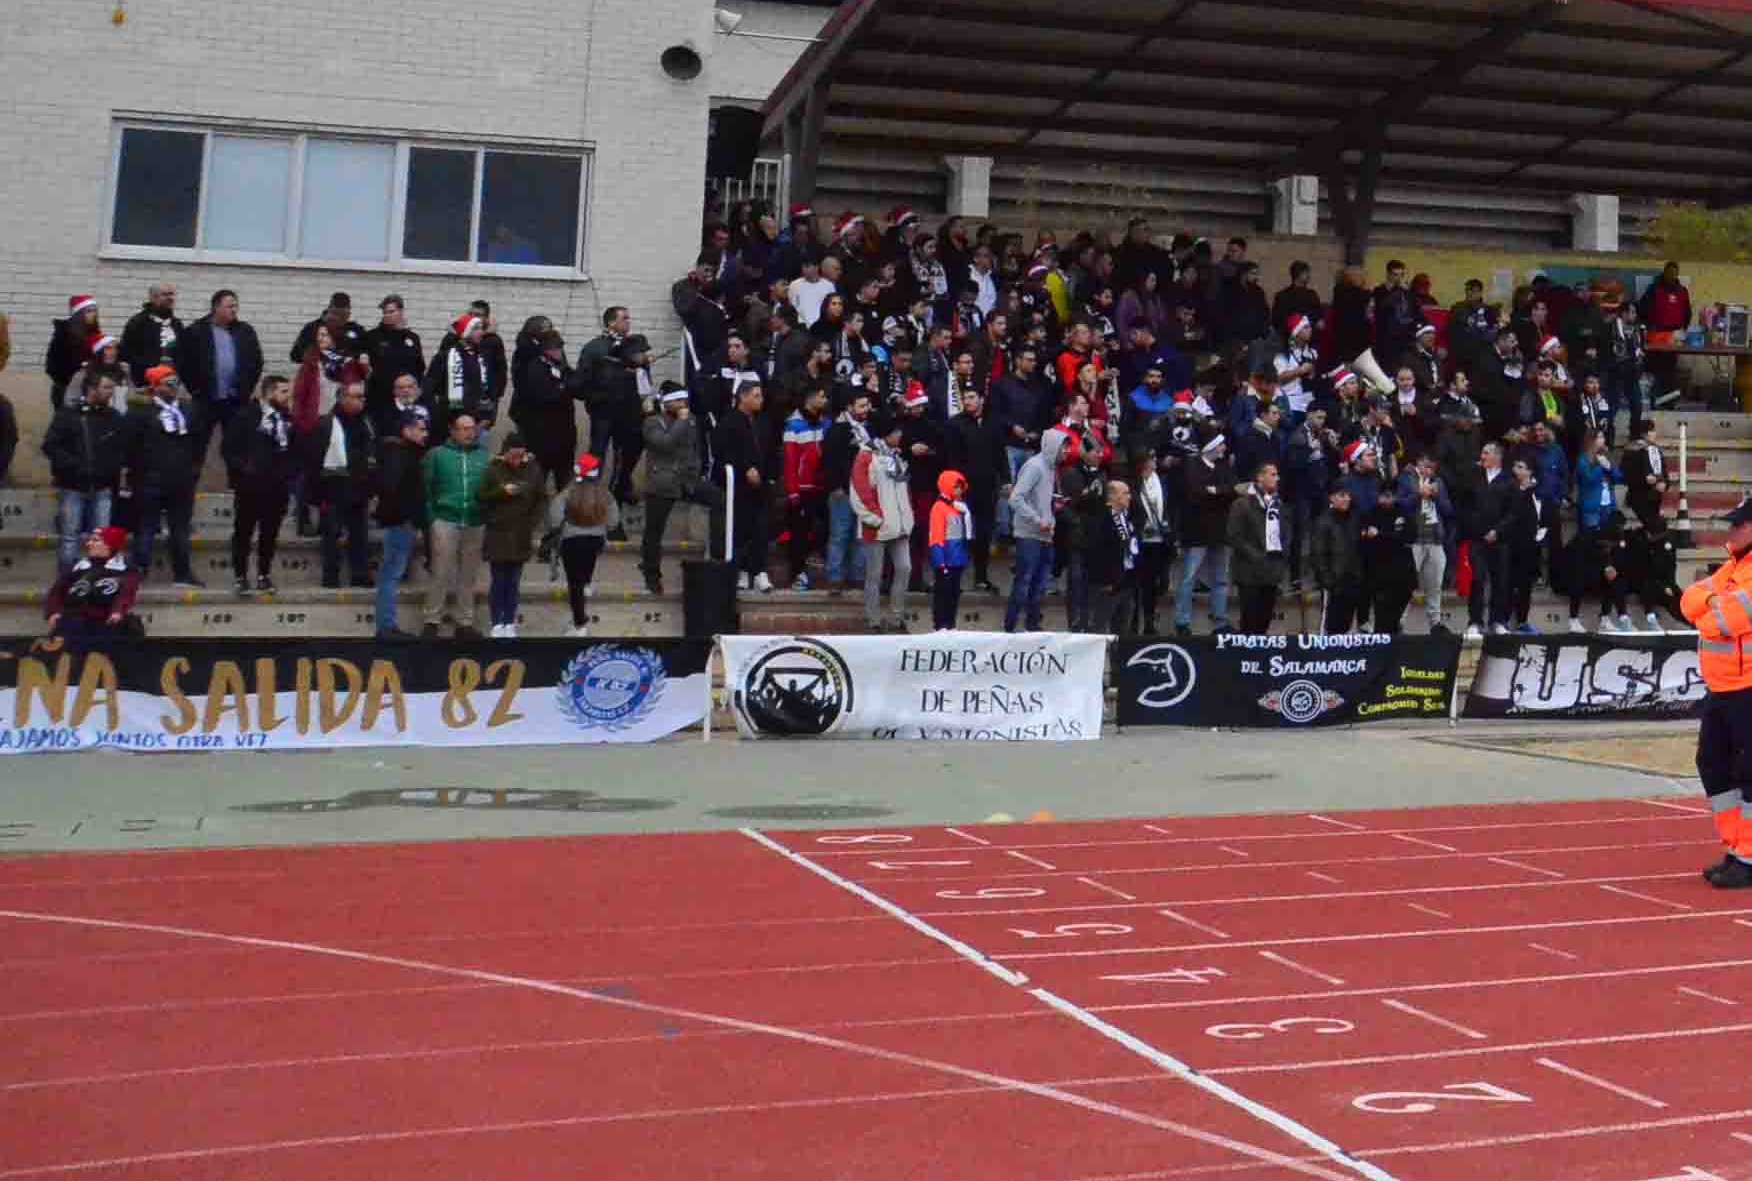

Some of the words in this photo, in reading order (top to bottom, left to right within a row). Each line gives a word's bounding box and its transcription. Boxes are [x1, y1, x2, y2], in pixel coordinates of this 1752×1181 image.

[900, 646, 1069, 674] FEDERACIÓN
[0, 637, 119, 732] ÑA
[160, 657, 408, 735] SALIDA
[440, 658, 526, 728] 82
[920, 688, 952, 713] DE
[962, 685, 1045, 714] PEÑAS
[815, 834, 913, 844] 8
[936, 887, 1047, 900] 6
[1008, 923, 1134, 939] 5
[1098, 967, 1229, 984] 4
[1205, 1015, 1355, 1041] 3
[1352, 1081, 1535, 1114] 2
